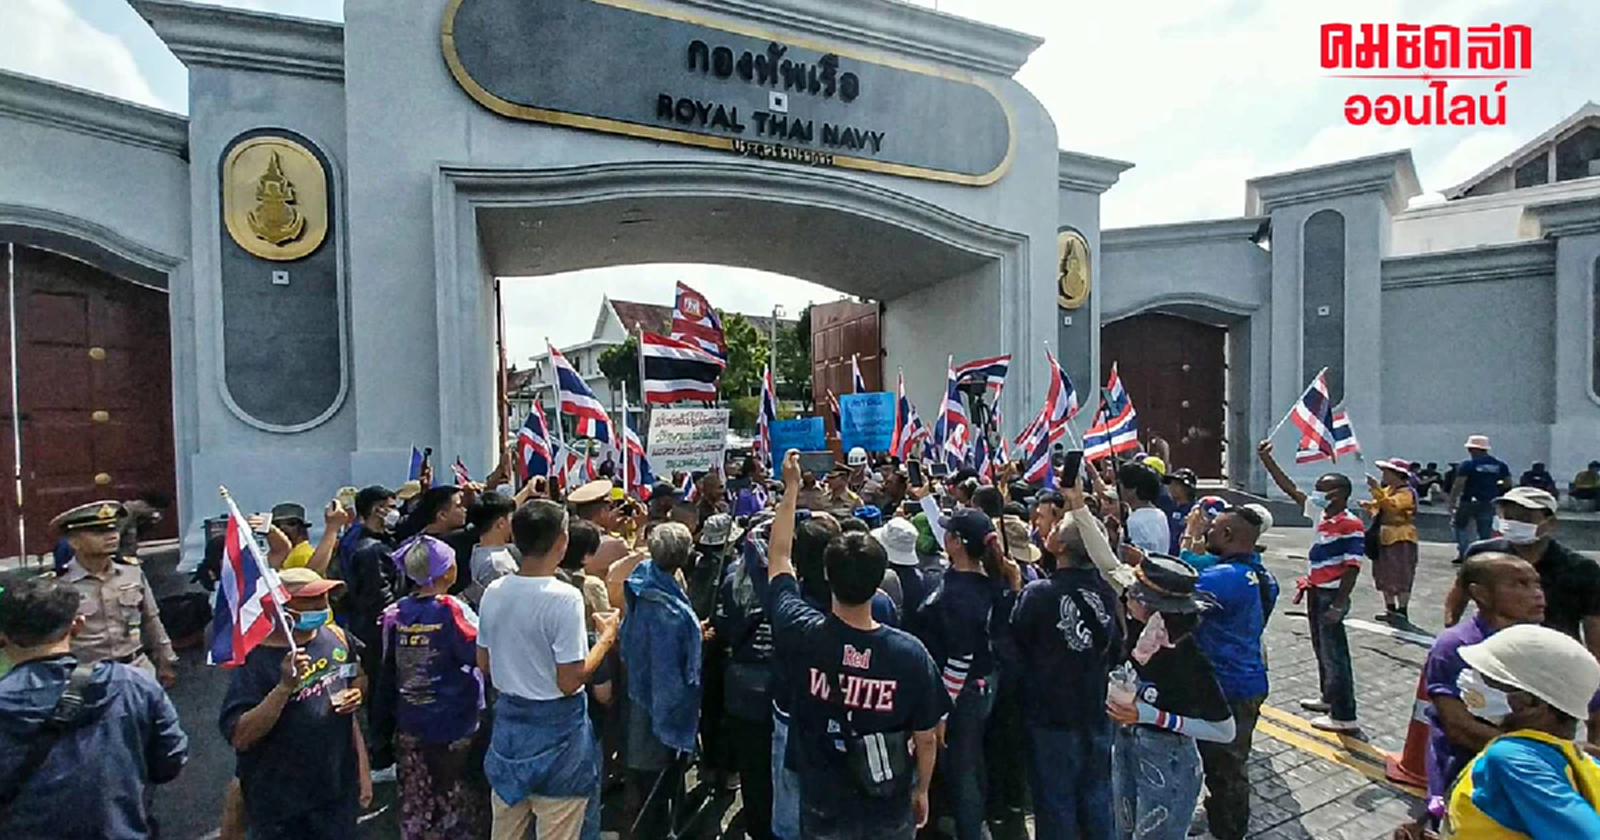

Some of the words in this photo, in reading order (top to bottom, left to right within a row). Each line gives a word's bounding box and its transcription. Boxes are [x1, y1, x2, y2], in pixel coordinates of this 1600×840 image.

[687, 40, 859, 102] กองทัพเรือ
[657, 93, 745, 133] ROYAL
[752, 111, 813, 143] THAI
[822, 123, 885, 152] NAVY
[842, 644, 872, 669] Red
